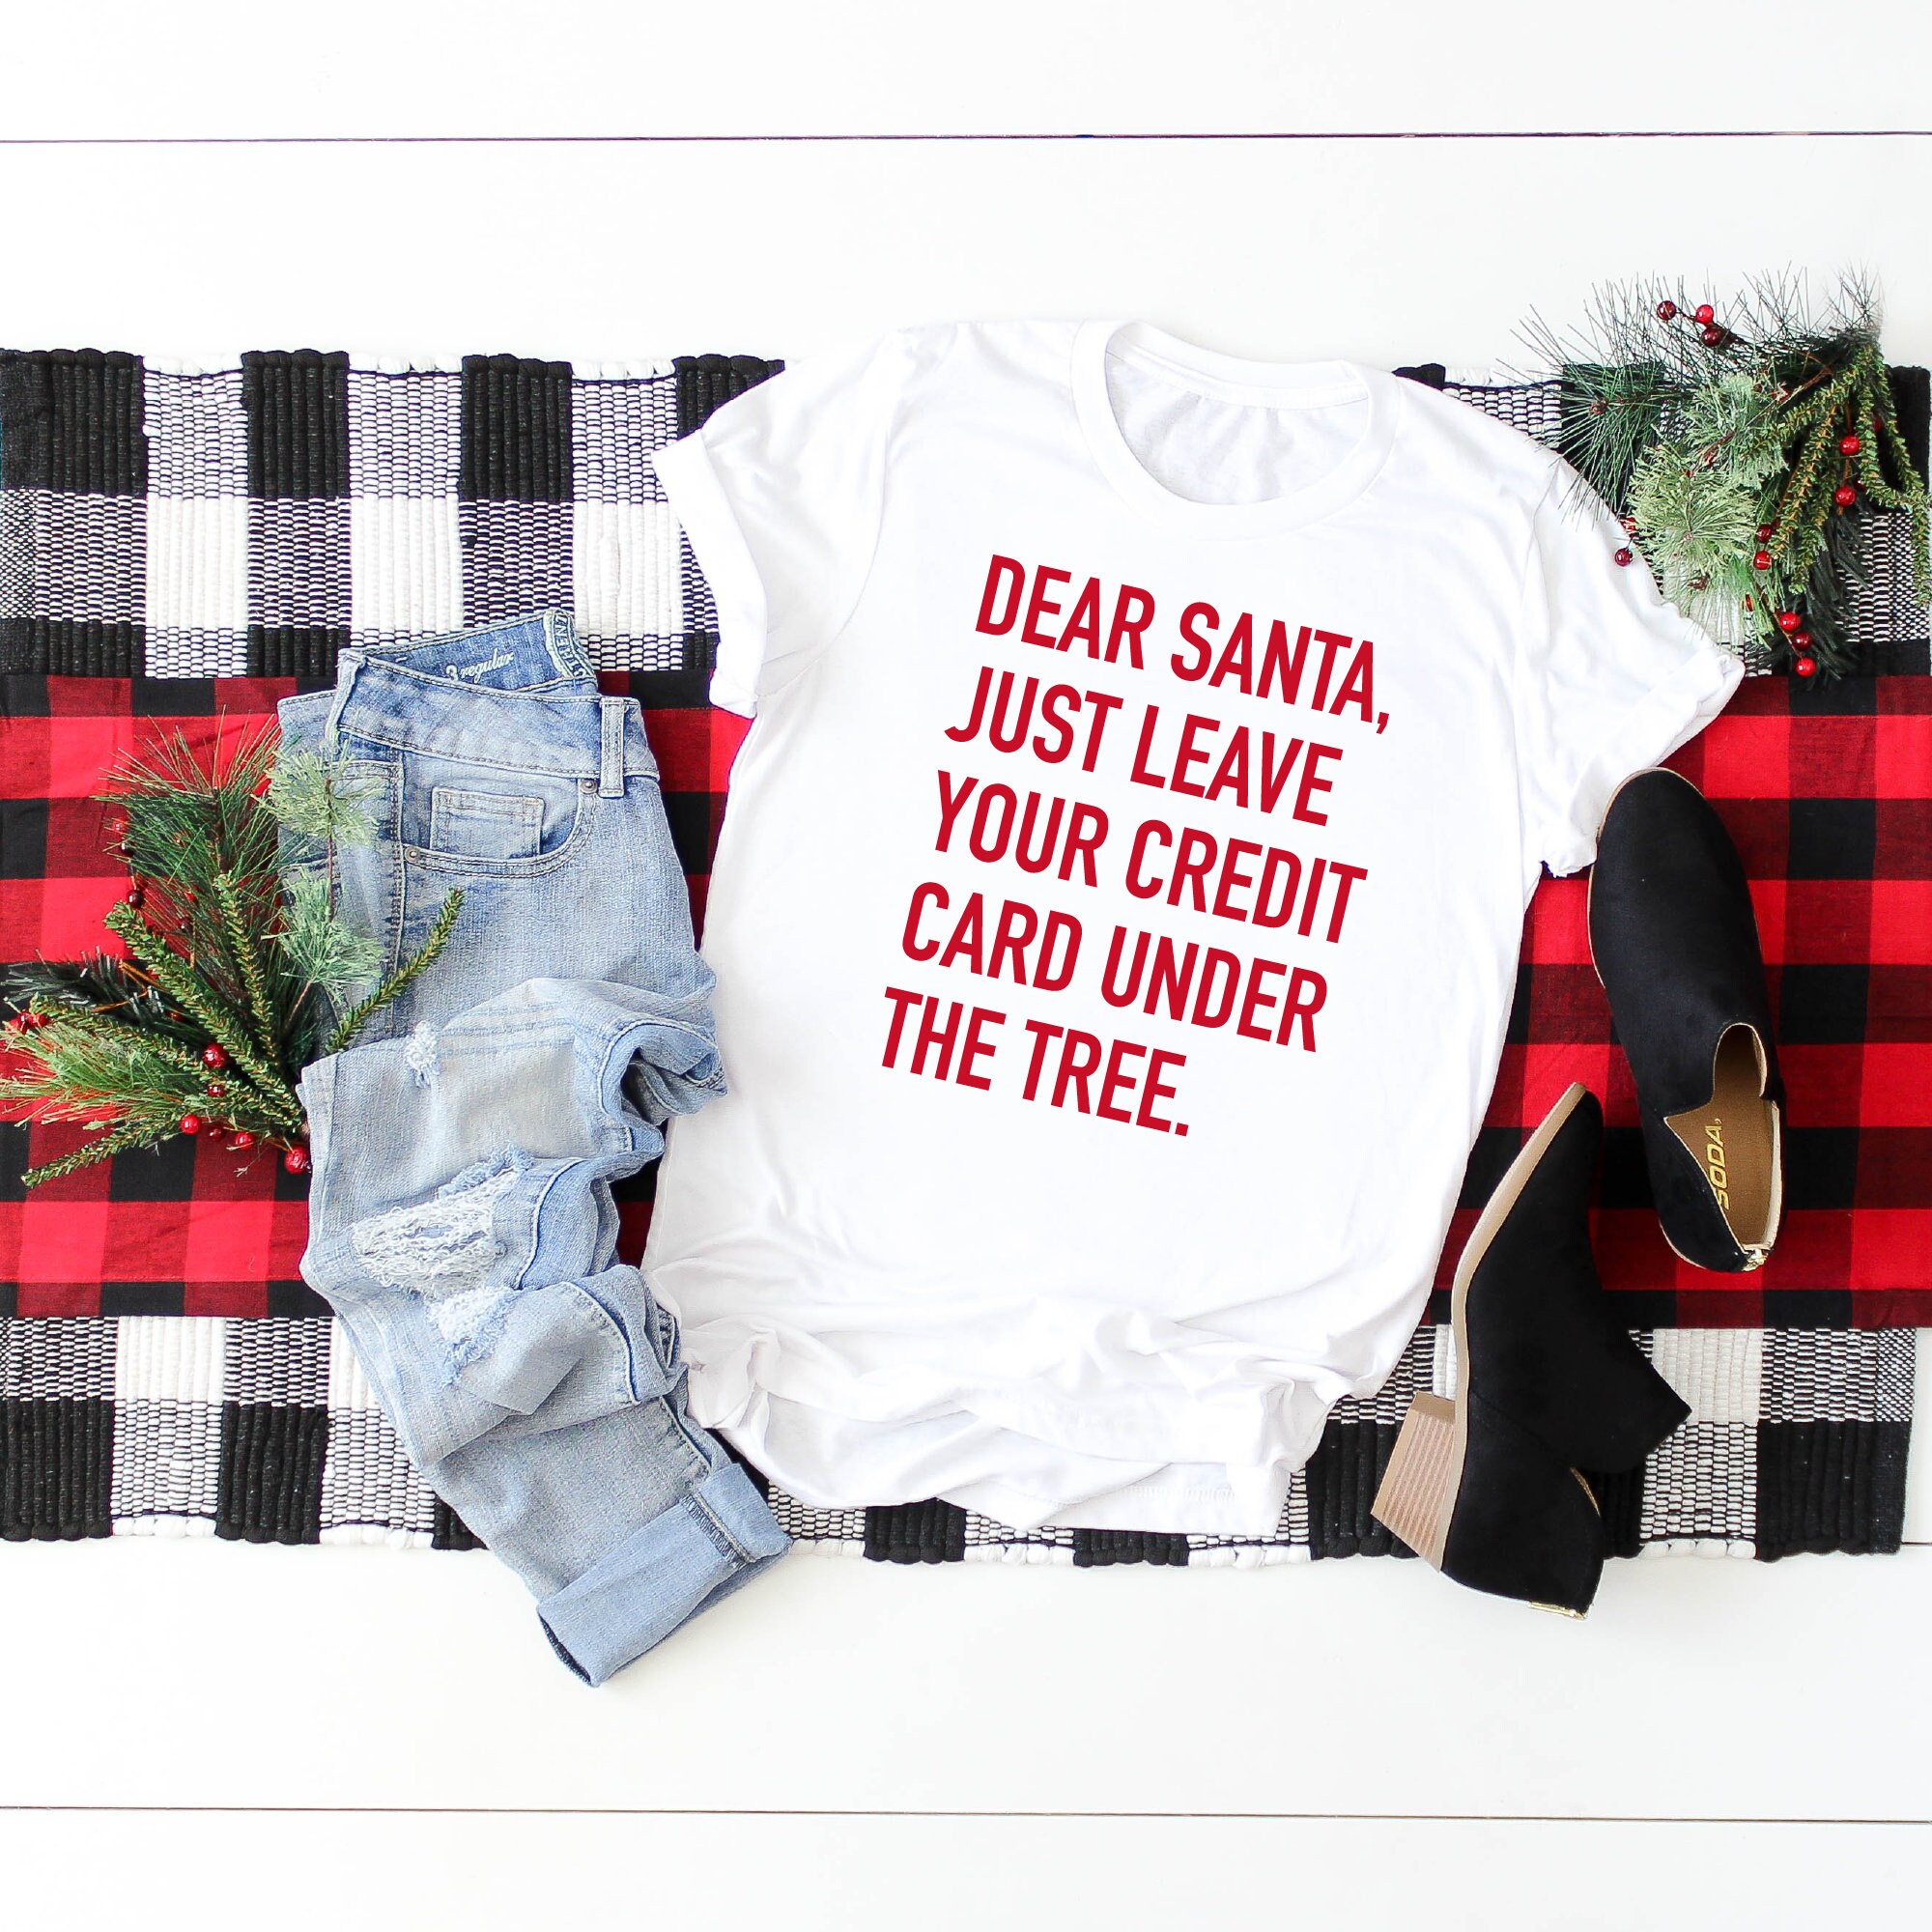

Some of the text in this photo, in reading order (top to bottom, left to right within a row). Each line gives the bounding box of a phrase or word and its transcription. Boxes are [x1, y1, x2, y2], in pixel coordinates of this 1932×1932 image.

[460, 648, 515, 683] regular
[976, 554, 1389, 734] DEAR SANTA,
[945, 667, 1343, 826] JUST LEAVE
[935, 771, 1368, 943] YOUR CREDIT
[902, 882, 1327, 1052] CARD UNDER
[882, 987, 1188, 1136] THE TREE.
